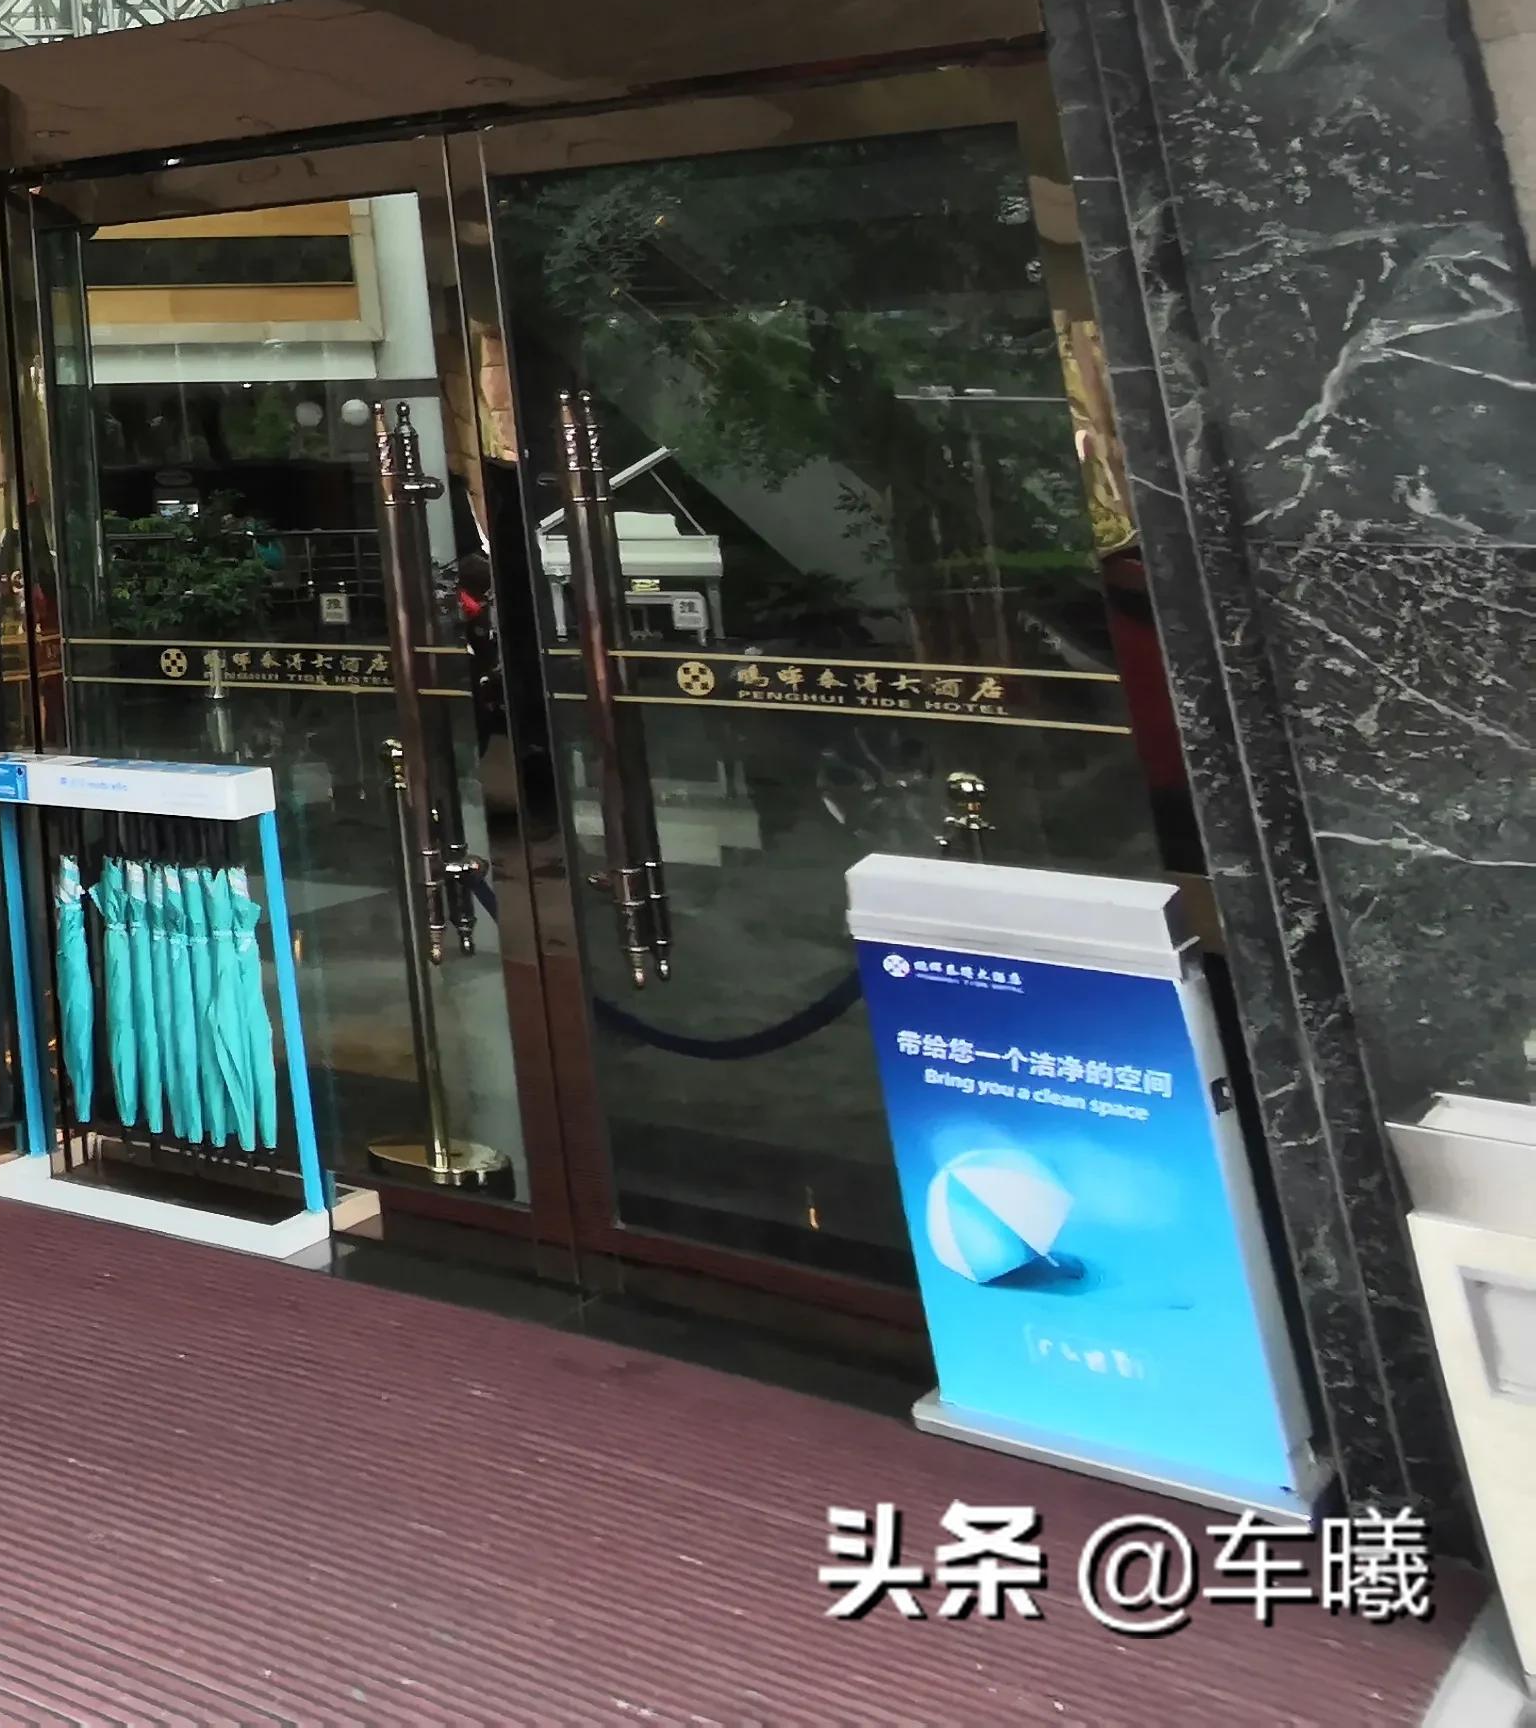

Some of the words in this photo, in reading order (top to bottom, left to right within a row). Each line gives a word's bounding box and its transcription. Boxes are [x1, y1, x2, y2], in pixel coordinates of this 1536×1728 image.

[738, 689, 845, 705] PENGHUI
[856, 696, 912, 709] TIDE
[925, 700, 1009, 716] HOTEL
[896, 1029, 1173, 1099] 带给您一个洁净的空间
[924, 1068, 975, 1094] Bring
[978, 1078, 1015, 1098] you
[1033, 1088, 1087, 1111] clean
[1089, 1099, 1151, 1122] space
